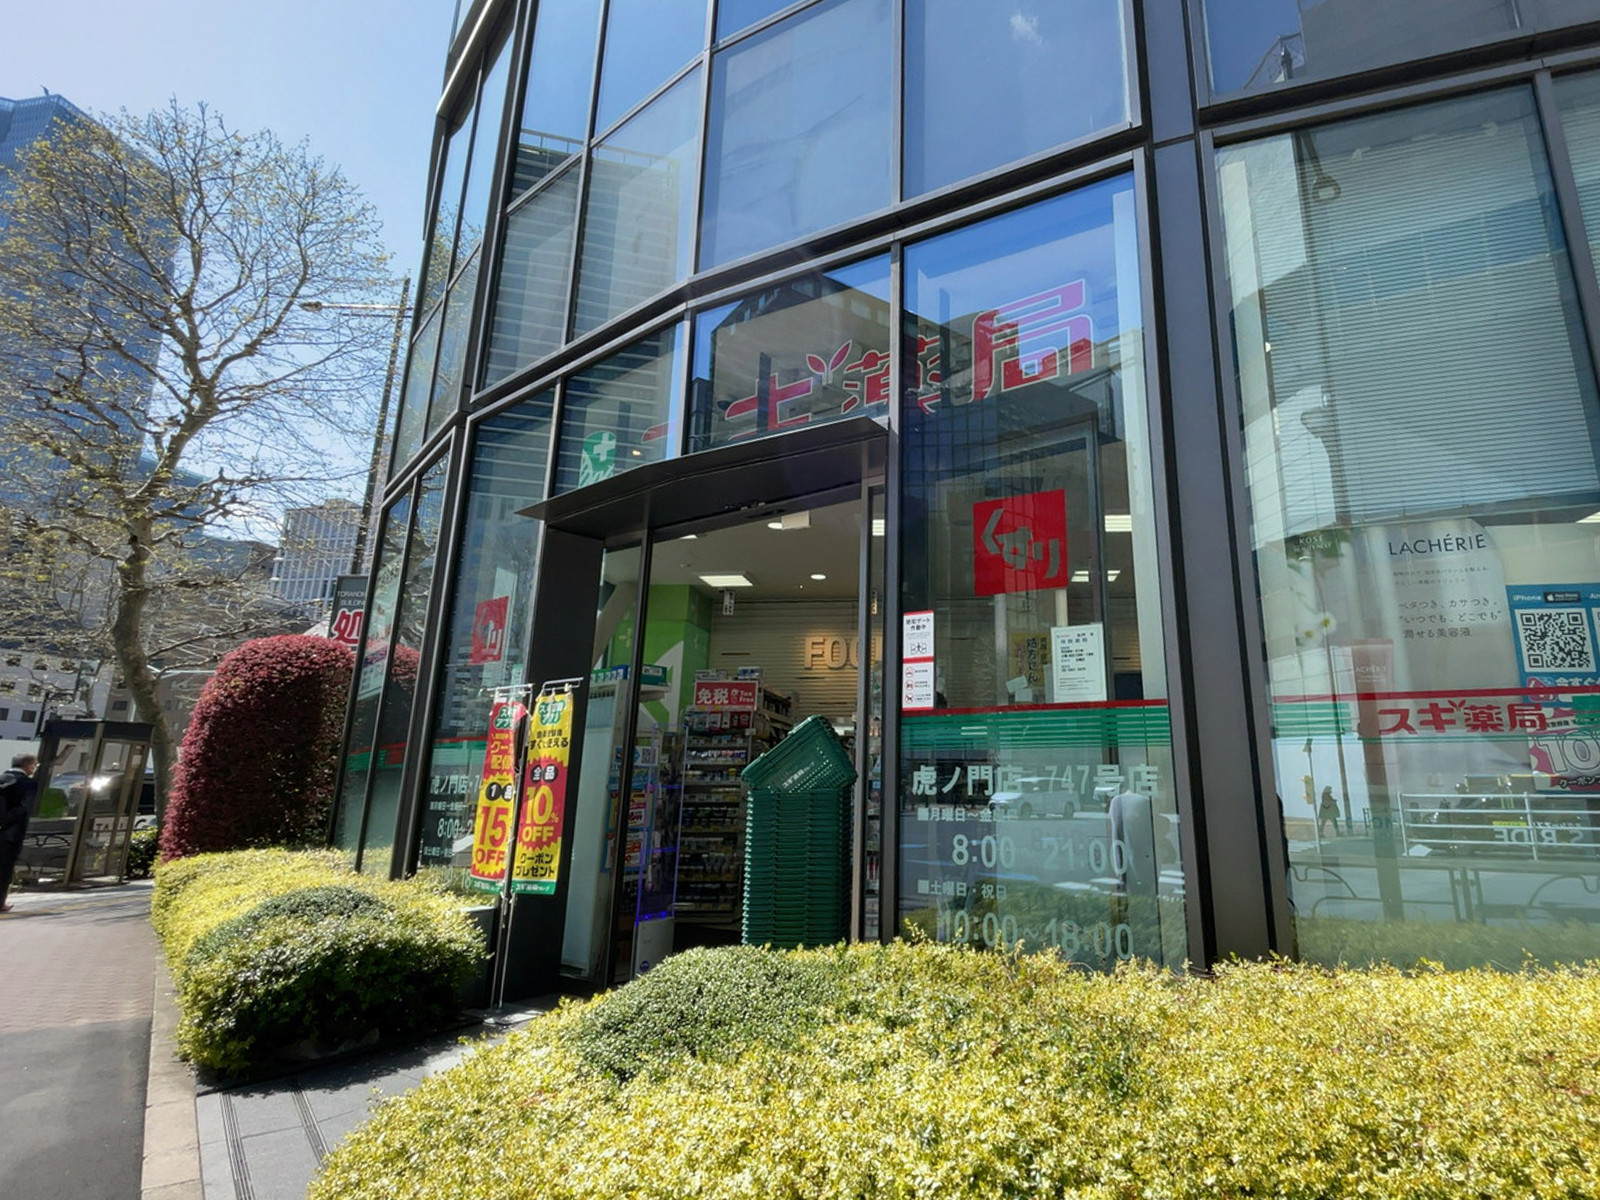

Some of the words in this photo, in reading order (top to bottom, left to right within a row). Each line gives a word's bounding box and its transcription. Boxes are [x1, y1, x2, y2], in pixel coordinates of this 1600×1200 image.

[981, 508, 1060, 578] くすり
[1388, 533, 1487, 556] LACHÉRIE
[1379, 700, 1547, 735] スギ薬局
[532, 765, 556, 780] 全品
[522, 826, 555, 842] OFF
[475, 848, 505, 866] OFF
